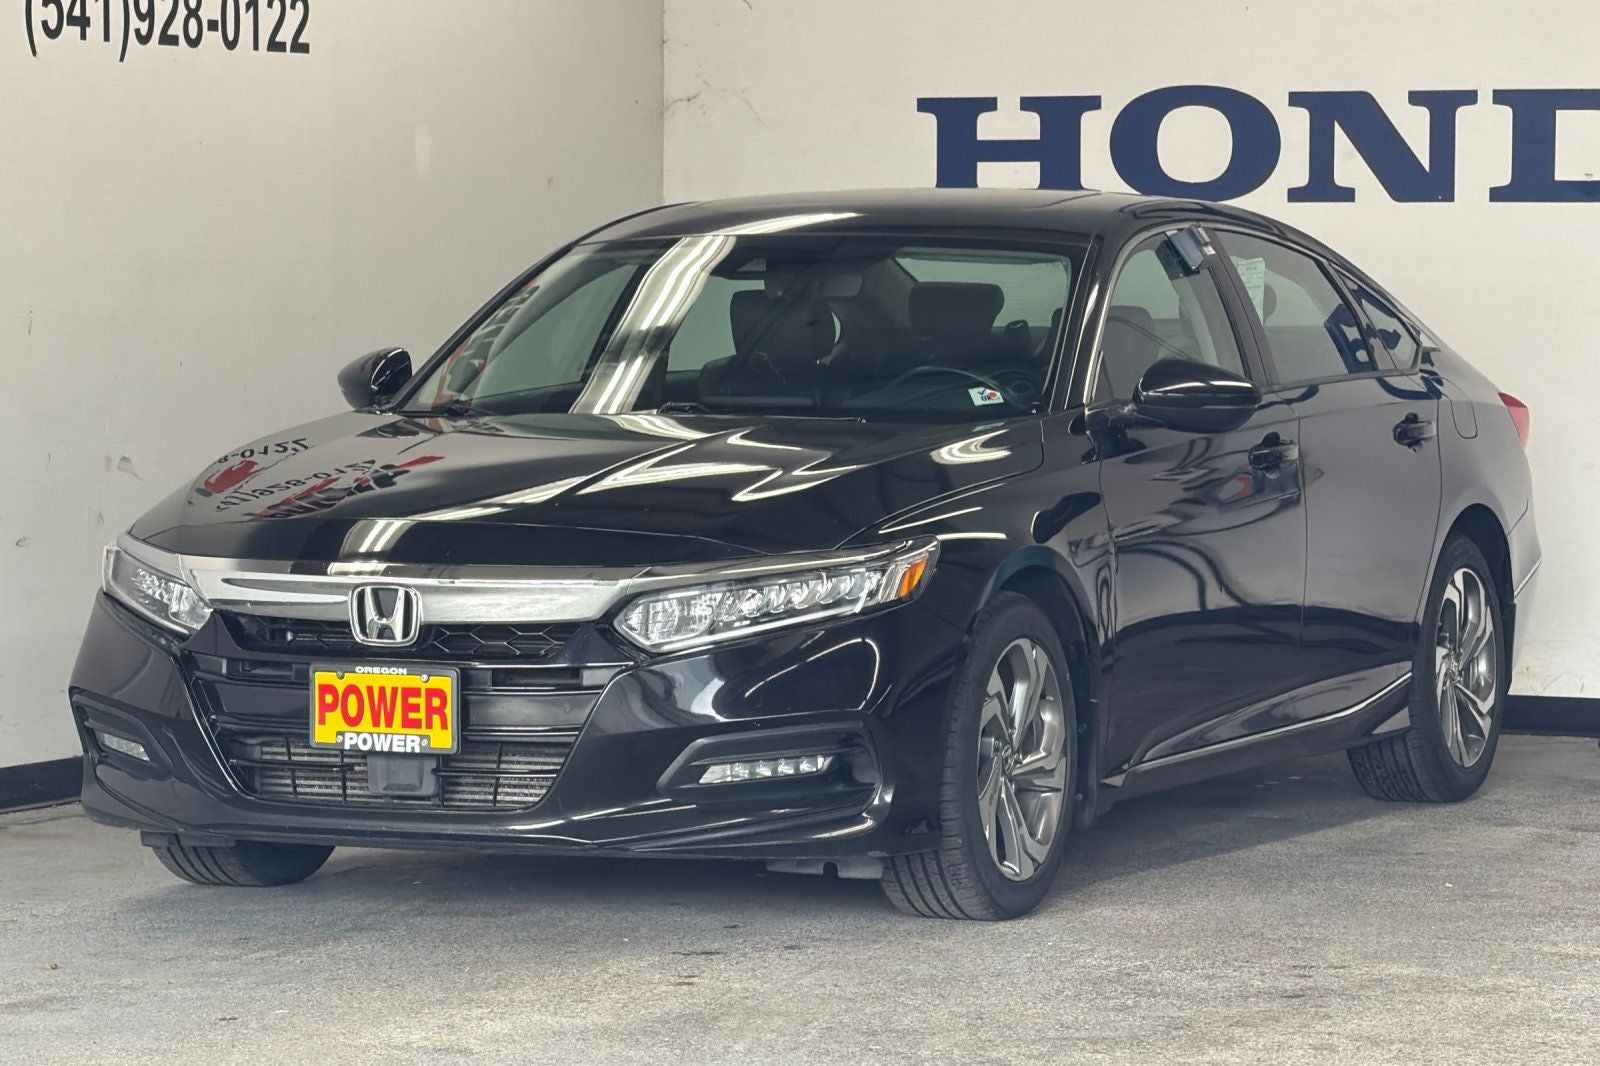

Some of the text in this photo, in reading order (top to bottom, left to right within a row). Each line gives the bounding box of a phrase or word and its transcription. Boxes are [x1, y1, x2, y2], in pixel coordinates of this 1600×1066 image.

[25, 0, 310, 62] (541)928-0122
[916, 84, 1600, 202] HOND
[355, 666, 408, 676] OREGON
[318, 684, 448, 730] POWER
[345, 733, 421, 753] POWER
